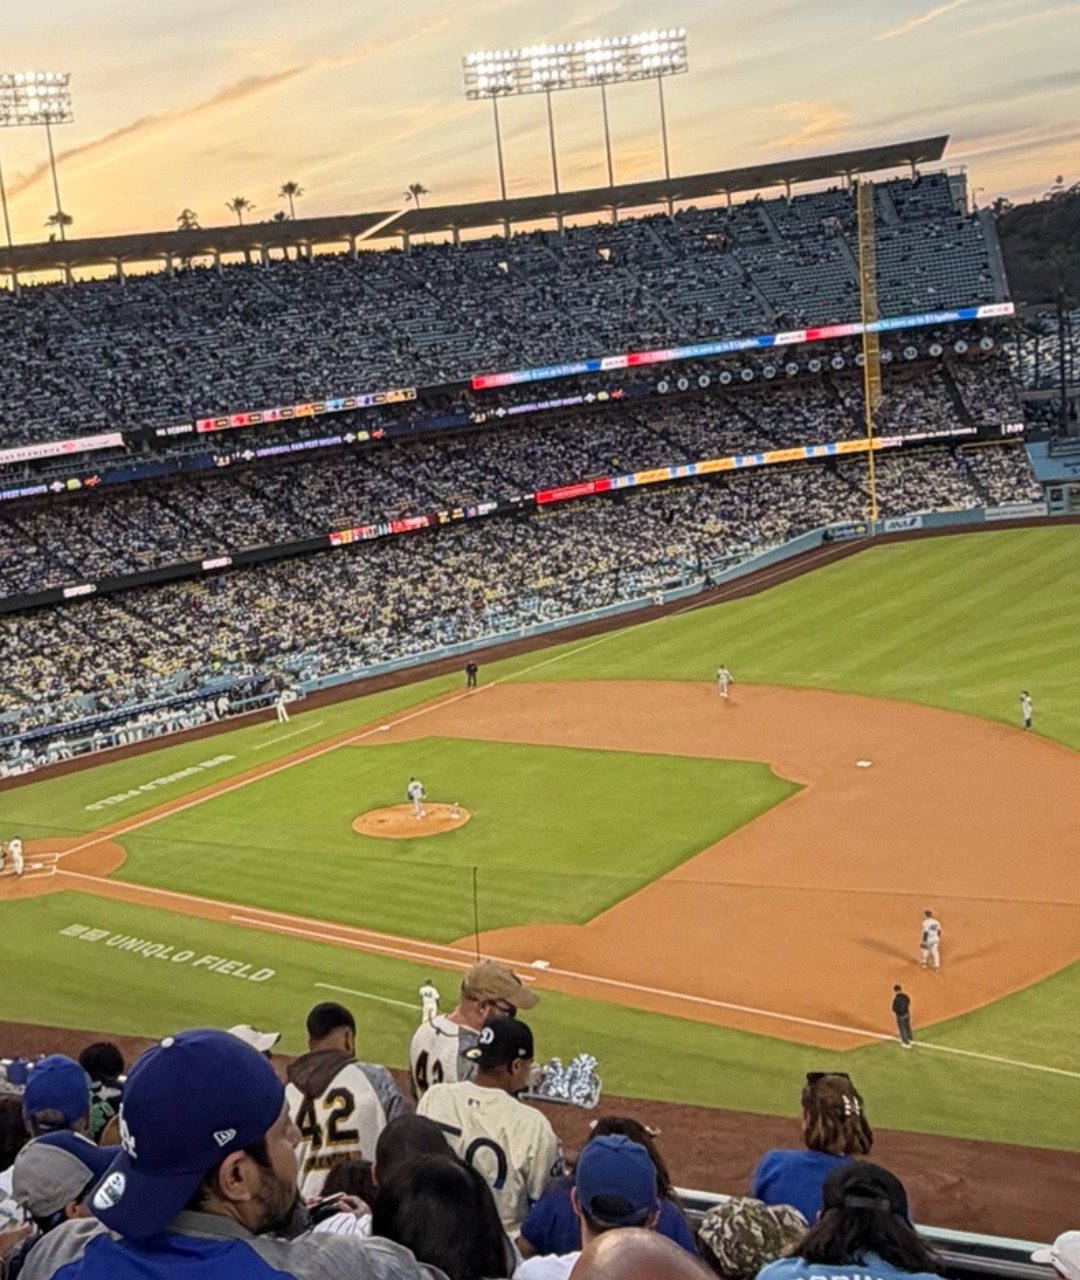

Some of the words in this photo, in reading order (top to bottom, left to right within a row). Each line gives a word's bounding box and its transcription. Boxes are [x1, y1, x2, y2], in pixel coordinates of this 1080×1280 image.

[3, 488, 20, 500] FEST
[887, 520, 910, 530] ANA
[105, 933, 195, 963] UNIQLO
[191, 954, 276, 983] FIELD
[295, 1086, 361, 1151] 42
